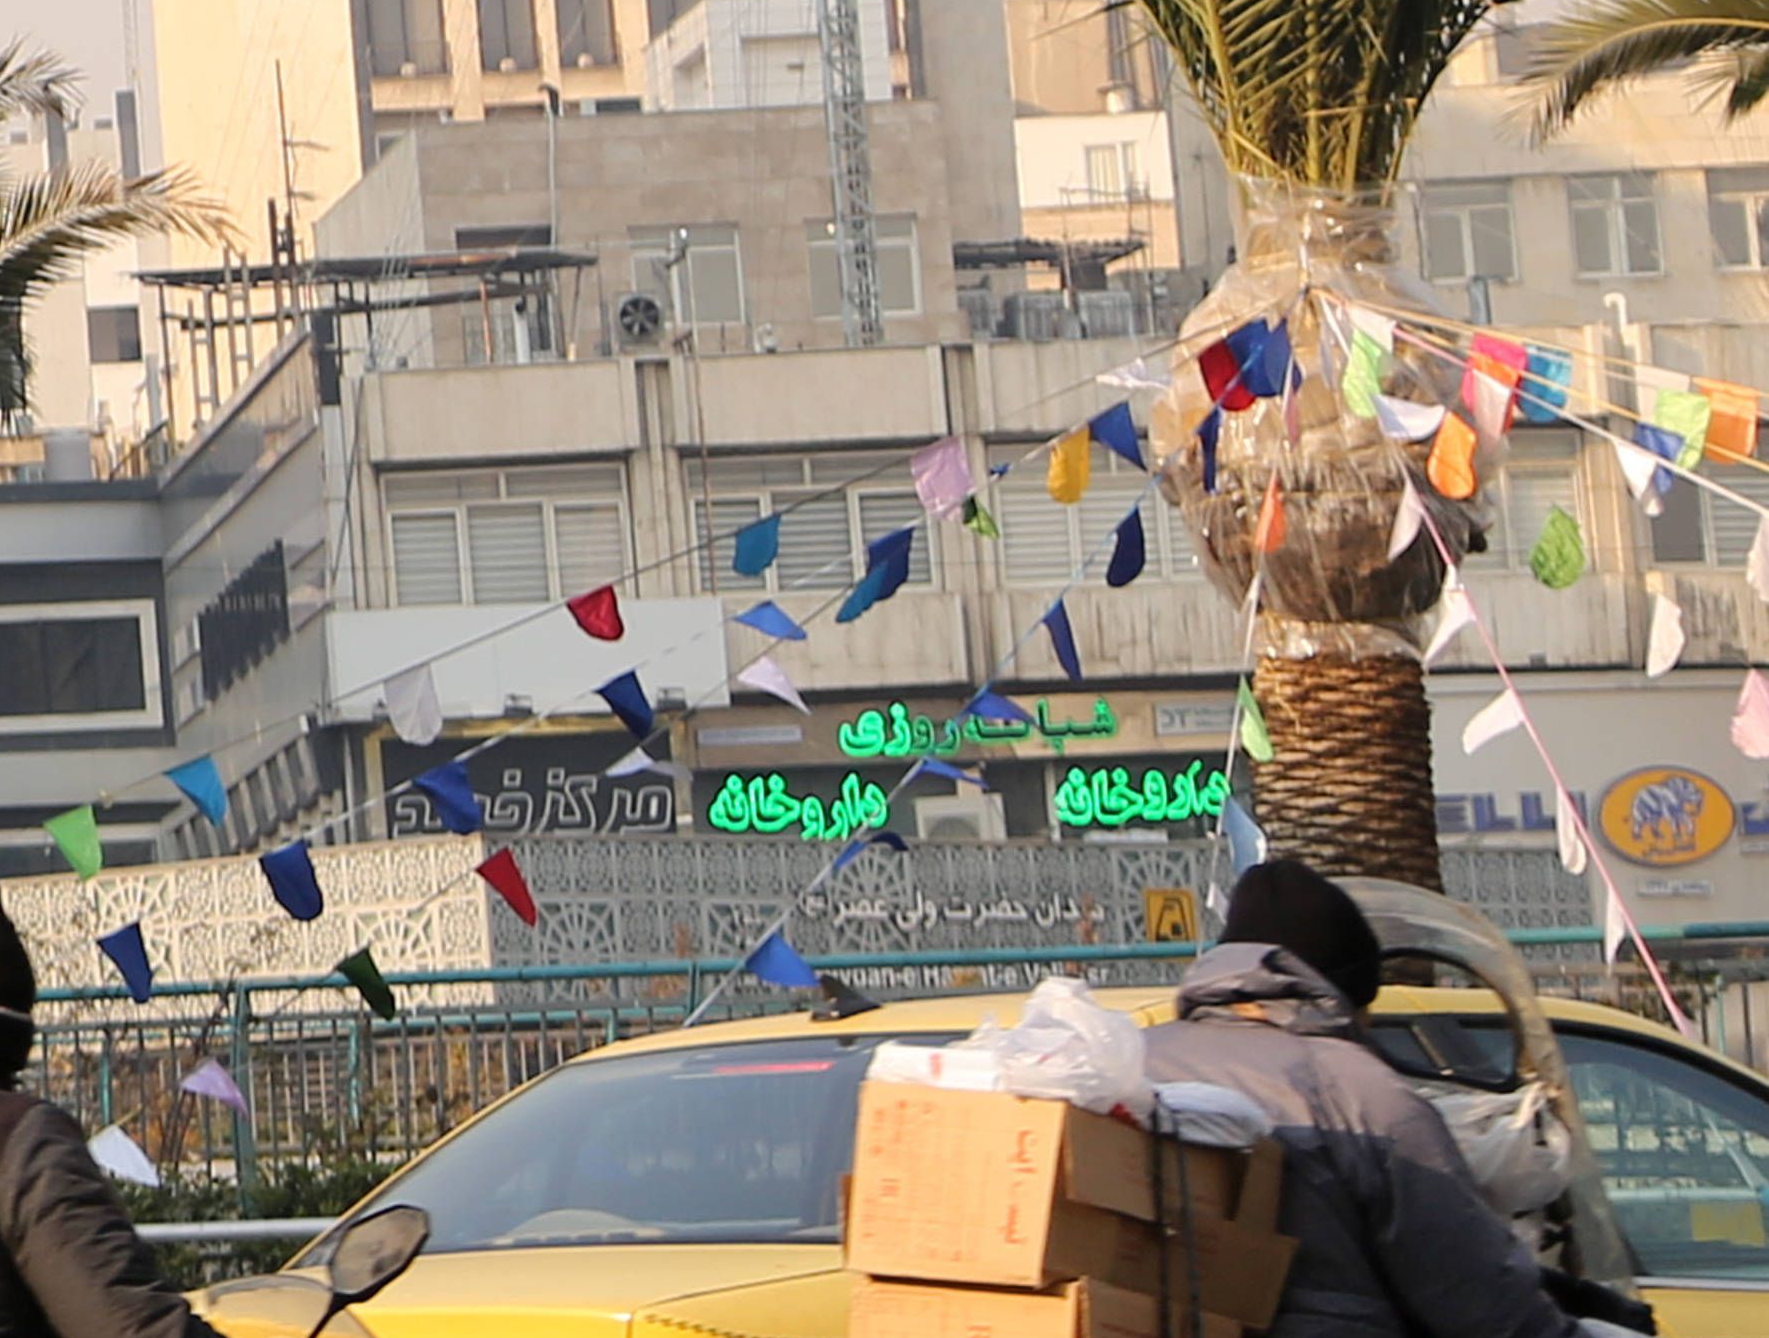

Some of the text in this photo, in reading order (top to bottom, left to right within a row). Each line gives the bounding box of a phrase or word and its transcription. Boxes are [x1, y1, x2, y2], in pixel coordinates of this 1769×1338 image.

[839, 702, 959, 757] روزی
[536, 767, 674, 835] مرکز
[708, 771, 889, 841] داروخانه
[1054, 759, 1232, 827] داروخانه
[894, 889, 938, 932] ولی
[943, 894, 1029, 928] حضرت
